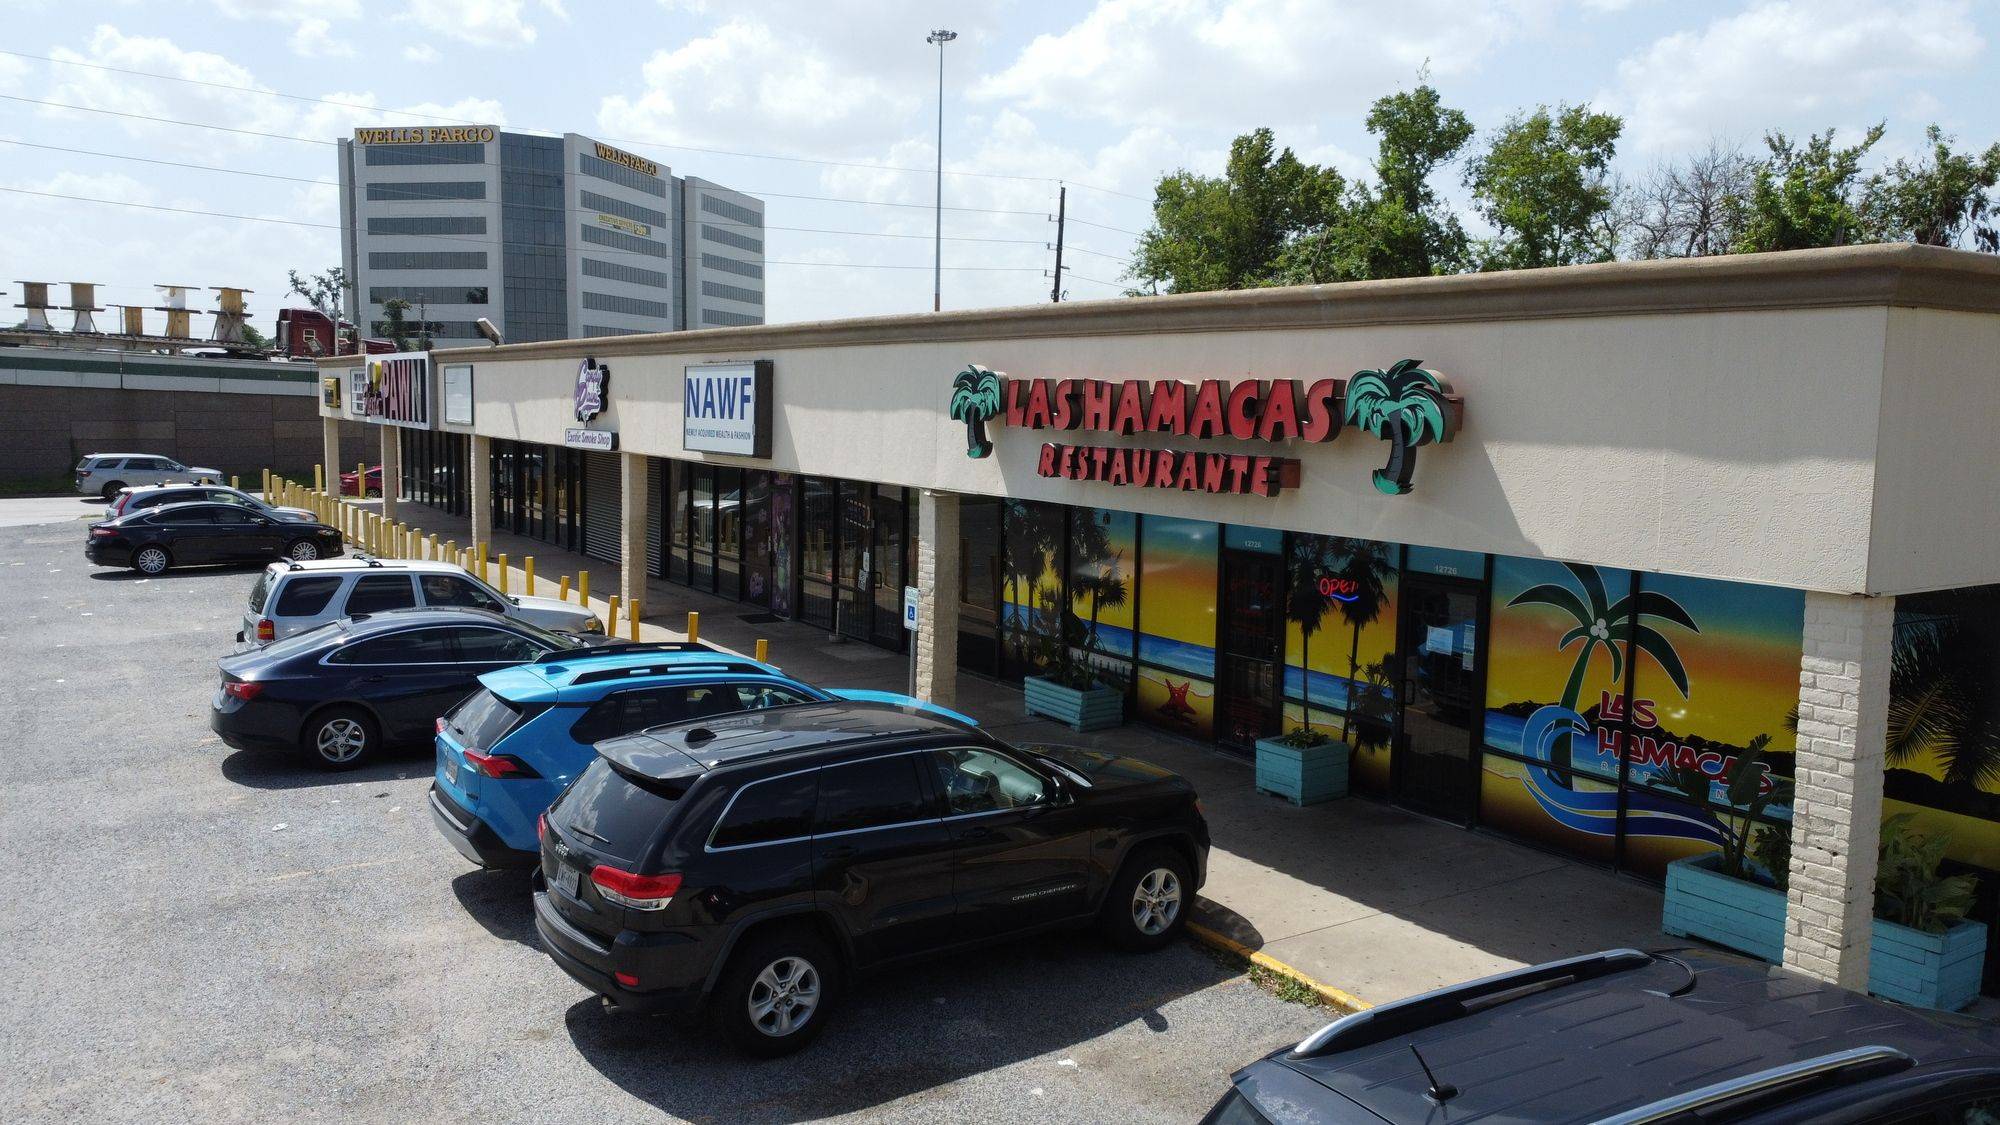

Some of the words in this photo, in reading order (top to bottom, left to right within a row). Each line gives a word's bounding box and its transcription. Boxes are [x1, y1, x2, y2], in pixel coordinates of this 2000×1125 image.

[360, 128, 423, 145] WELLS
[429, 127, 494, 143] FARGO
[595, 142, 630, 167] WELLS
[629, 154, 657, 177] FARGO
[382, 358, 427, 423] PAWN
[687, 377, 752, 420] NAWF
[1084, 378, 1342, 443] HAMACAS
[567, 430, 581, 443] Exotic
[582, 432, 597, 445] Smoke
[598, 433, 611, 448] Shop
[734, 431, 751, 440] FASHION
[1037, 442, 1278, 497] RESTAURANTE
[1434, 565, 1458, 576] 12726
[1599, 689, 1658, 730] LAS
